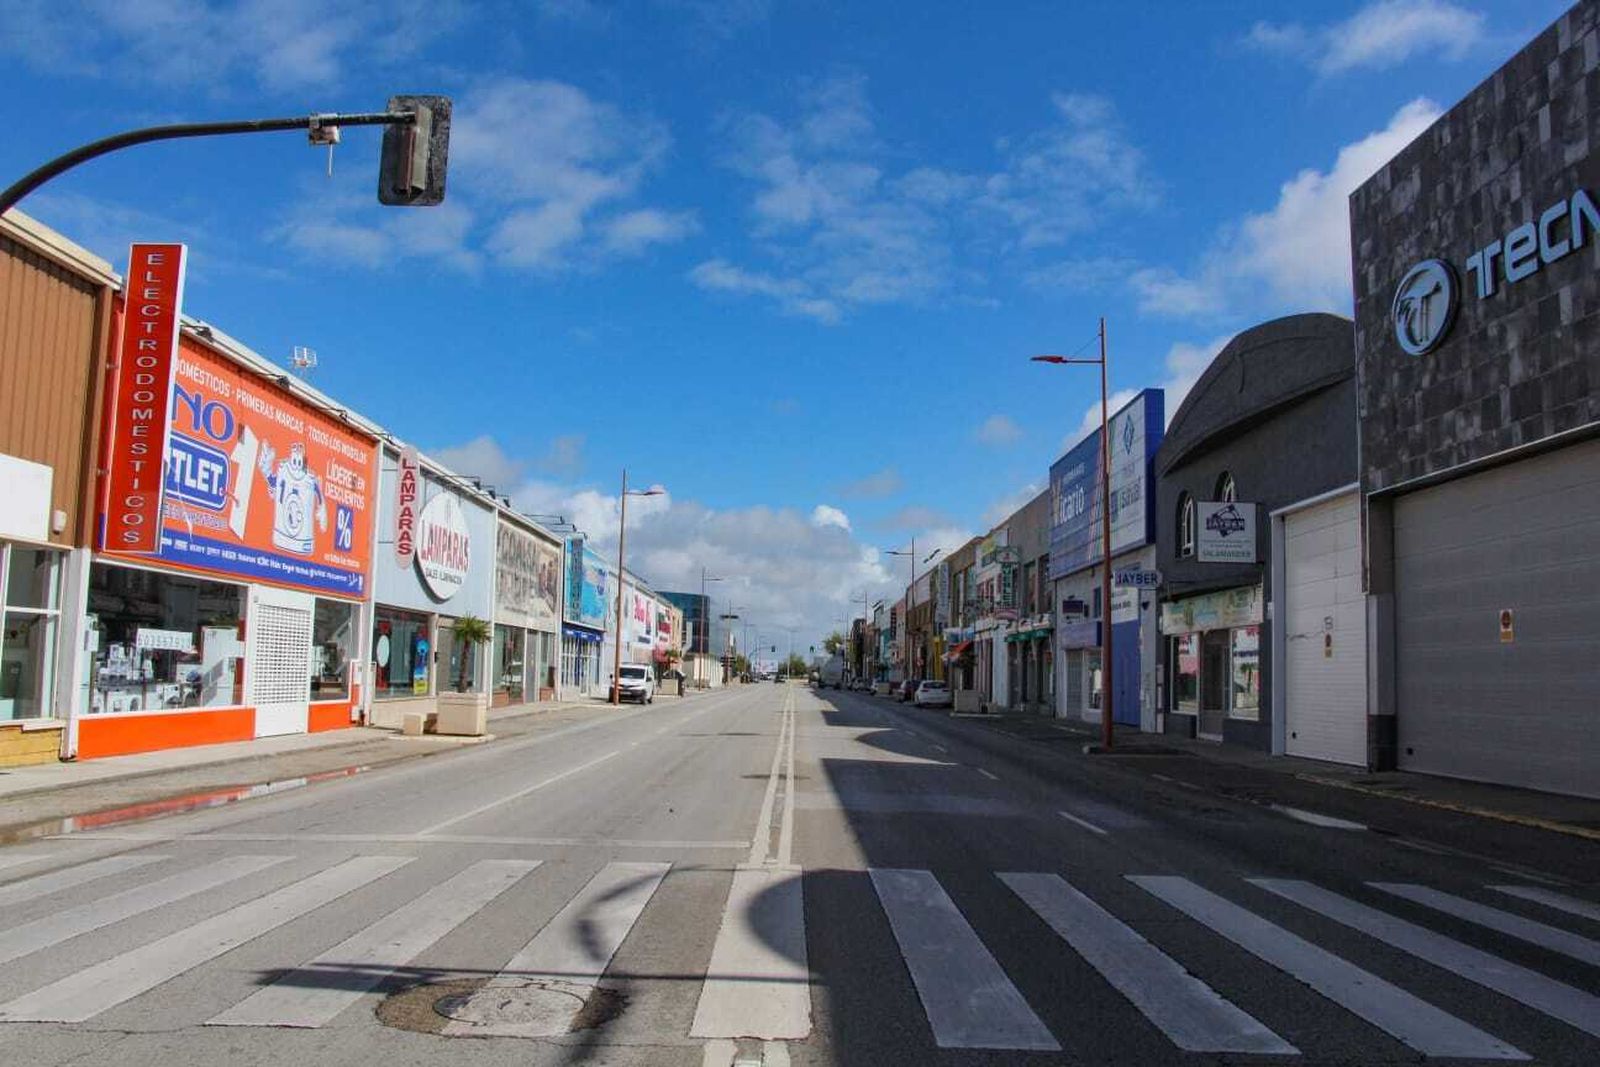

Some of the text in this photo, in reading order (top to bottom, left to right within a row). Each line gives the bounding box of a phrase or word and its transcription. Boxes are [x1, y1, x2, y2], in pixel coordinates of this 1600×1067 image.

[123, 252, 165, 544] ELECTRODOMESTICOS
[236, 388, 275, 420] PRIMERAS
[275, 408, 304, 434] MARCAS
[326, 458, 358, 489] LÍDERES
[325, 481, 365, 512] DESCUENTOS
[397, 458, 416, 556] LAMPARAS
[1115, 573, 1159, 585] JAYBER
